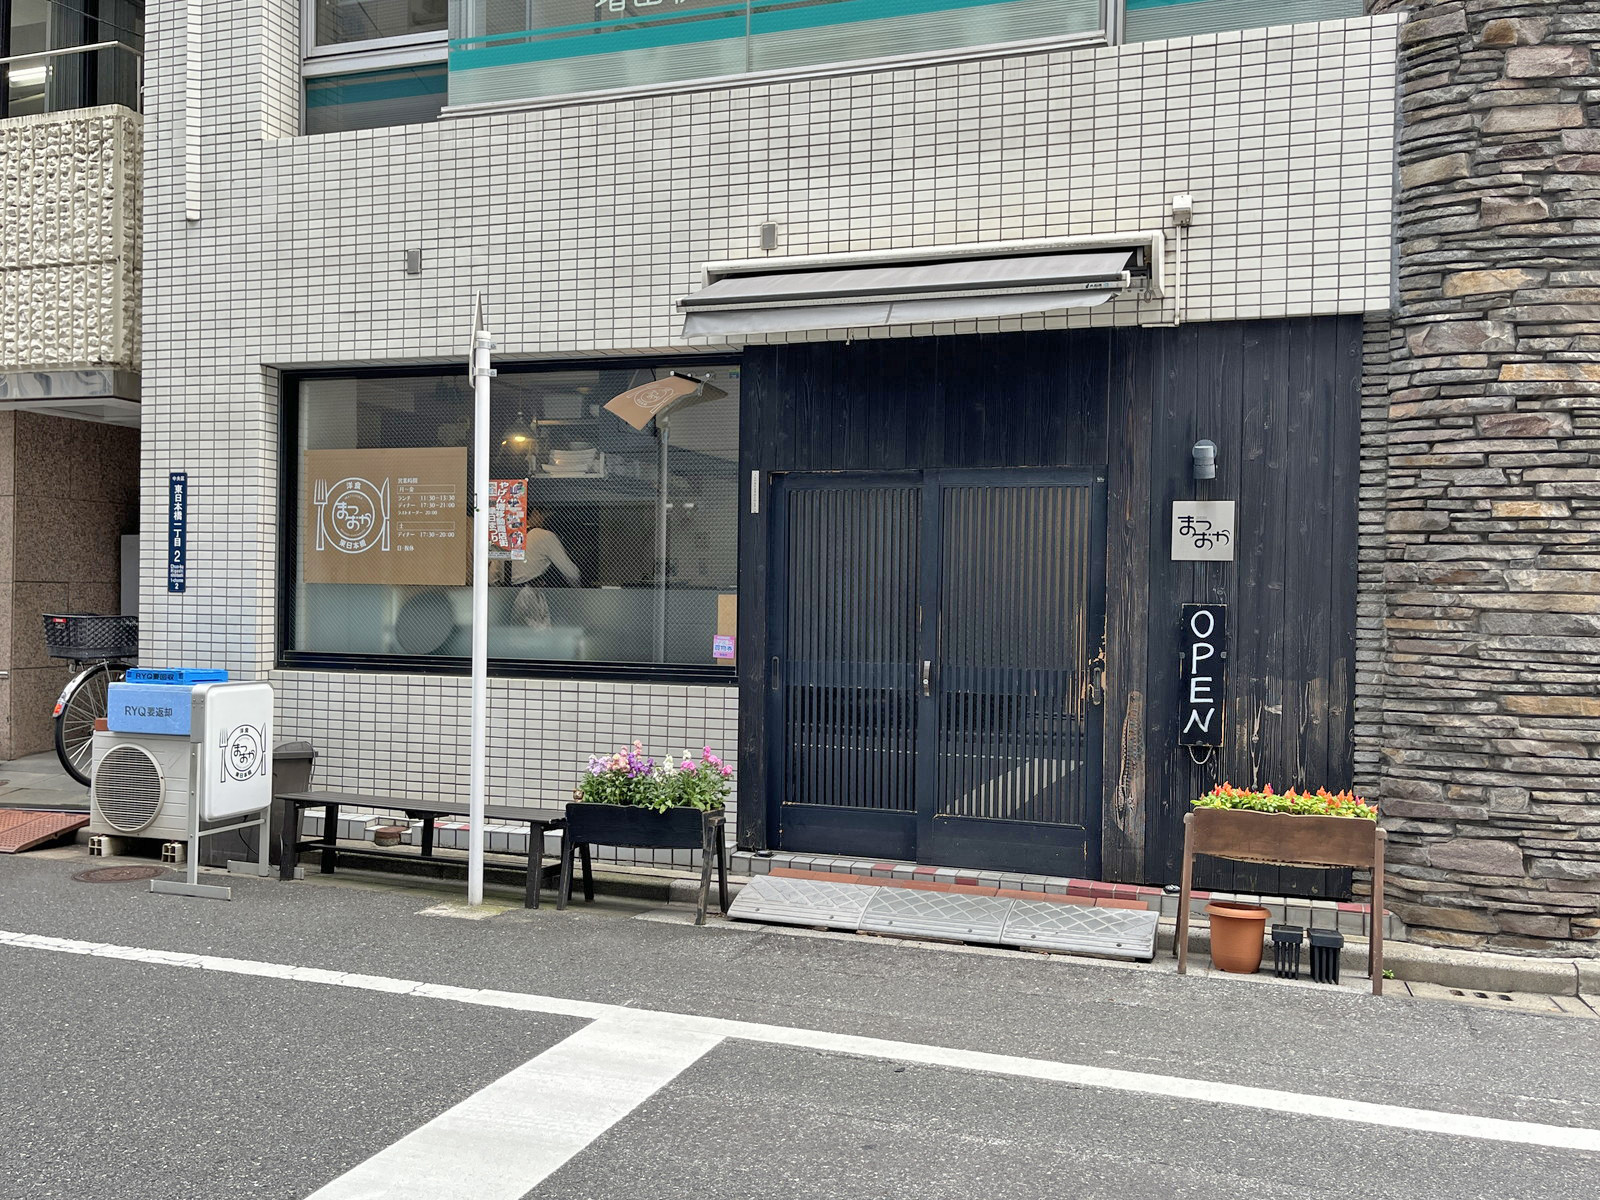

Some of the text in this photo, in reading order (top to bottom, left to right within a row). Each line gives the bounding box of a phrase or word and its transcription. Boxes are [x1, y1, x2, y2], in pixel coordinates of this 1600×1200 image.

[173, 484, 183, 547] 東日本橋一丁目
[339, 539, 367, 550] 東日本橋
[174, 550, 181, 562] 2
[174, 582, 179, 590] 2
[1183, 609, 1216, 734] OPEN
[124, 705, 173, 718] RYQ要返却
